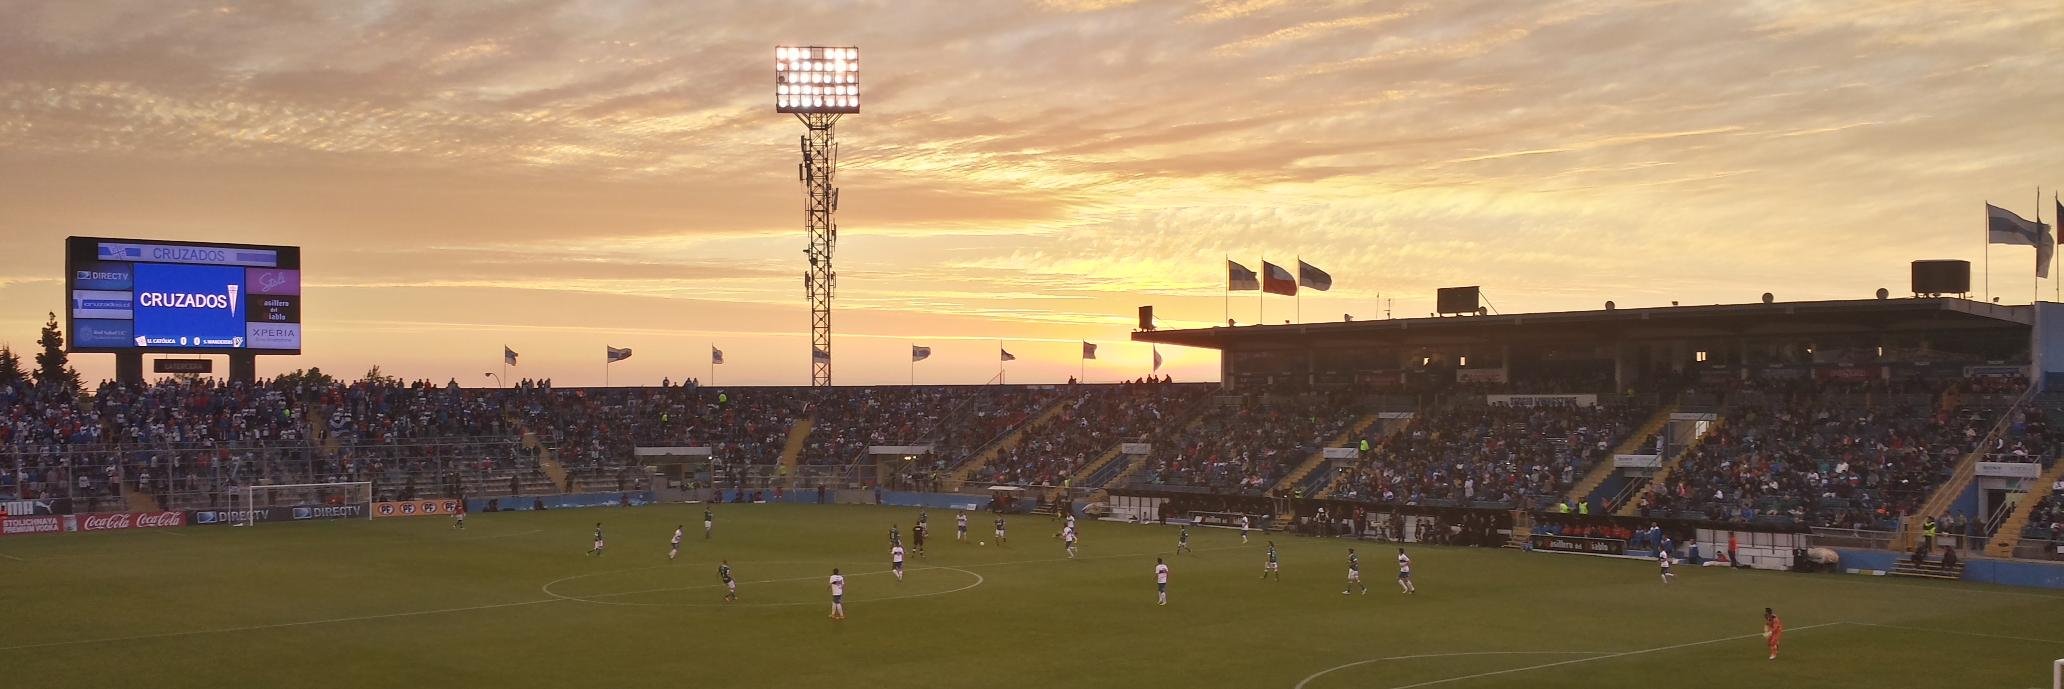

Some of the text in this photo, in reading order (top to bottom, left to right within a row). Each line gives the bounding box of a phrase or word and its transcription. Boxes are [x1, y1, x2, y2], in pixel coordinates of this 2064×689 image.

[153, 247, 224, 261] CRUZADOS
[92, 271, 128, 280] DIRECTV
[140, 292, 227, 309] CRUZADOS
[264, 299, 290, 307] asillero
[253, 328, 295, 337] XPERIA
[180, 337, 187, 346] 0
[194, 337, 201, 346] 0
[8, 501, 34, 516] MA
[314, 505, 361, 517] DIRECTV
[218, 509, 270, 522] DIRECTV
